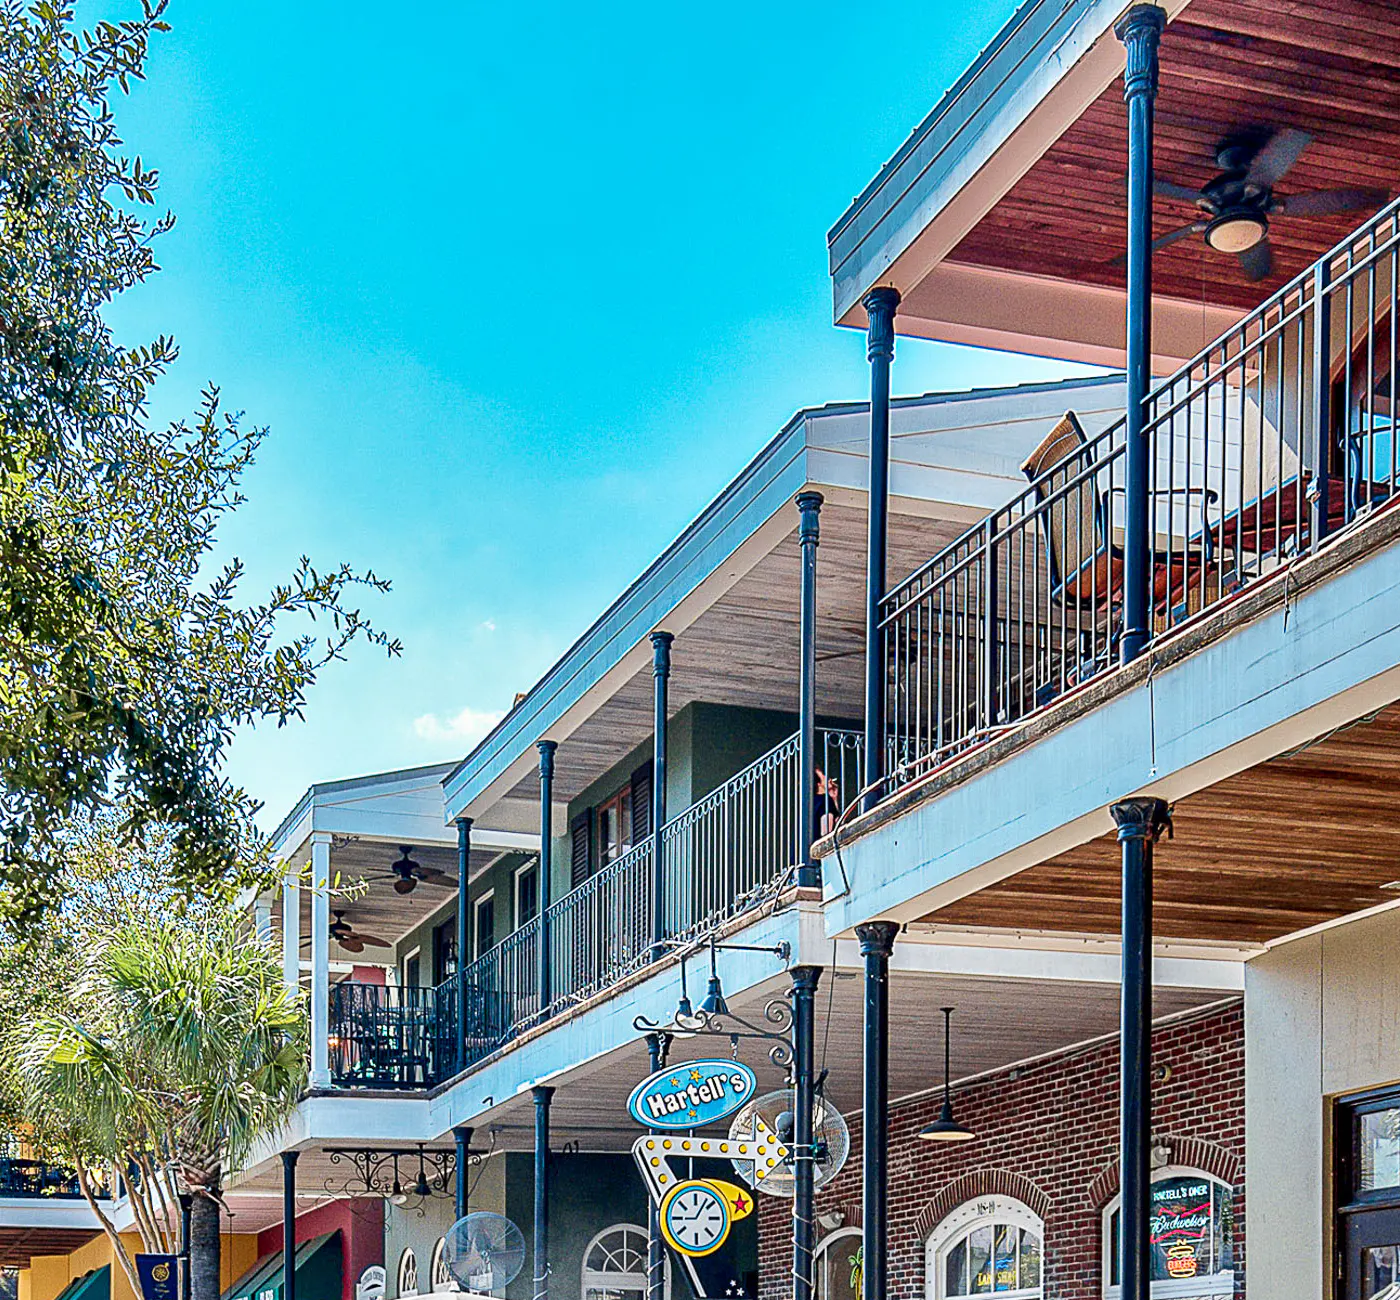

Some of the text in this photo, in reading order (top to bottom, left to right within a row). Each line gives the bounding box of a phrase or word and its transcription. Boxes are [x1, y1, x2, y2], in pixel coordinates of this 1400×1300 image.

[646, 1073, 746, 1118] Hartell's
[1149, 1214, 1210, 1234] Budweiser
[1167, 1258, 1197, 1271] BURGERS
